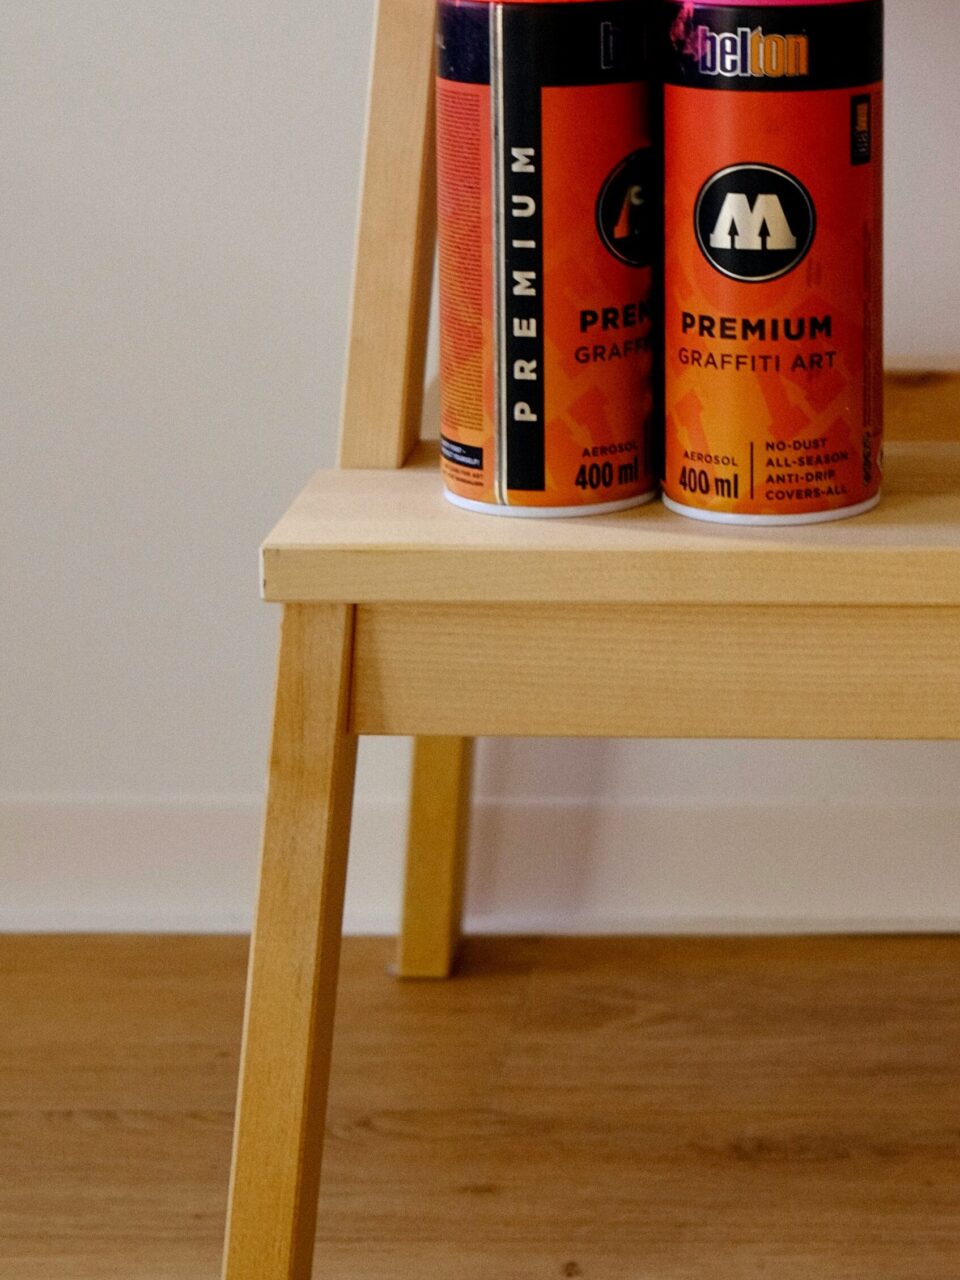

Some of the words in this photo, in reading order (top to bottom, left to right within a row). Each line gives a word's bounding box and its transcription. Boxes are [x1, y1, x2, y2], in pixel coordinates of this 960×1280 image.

[697, 25, 809, 77] belton
[709, 192, 797, 251] M
[511, 147, 537, 422] PREMIUM
[682, 311, 832, 341] PREMIUM
[678, 347, 780, 372] GRAFFITI
[791, 351, 837, 372] ART
[582, 440, 638, 458] AEROSOL
[765, 438, 827, 452] NO-DUST
[682, 450, 738, 467] AEROSOL
[765, 451, 849, 468] ALL-SEASON
[575, 461, 613, 490] 400
[618, 455, 638, 485] ml
[679, 466, 710, 495] 400
[715, 473, 739, 499] ml
[765, 469, 836, 484] ANTI-DRIP
[765, 485, 847, 501] COVERS-ALL
